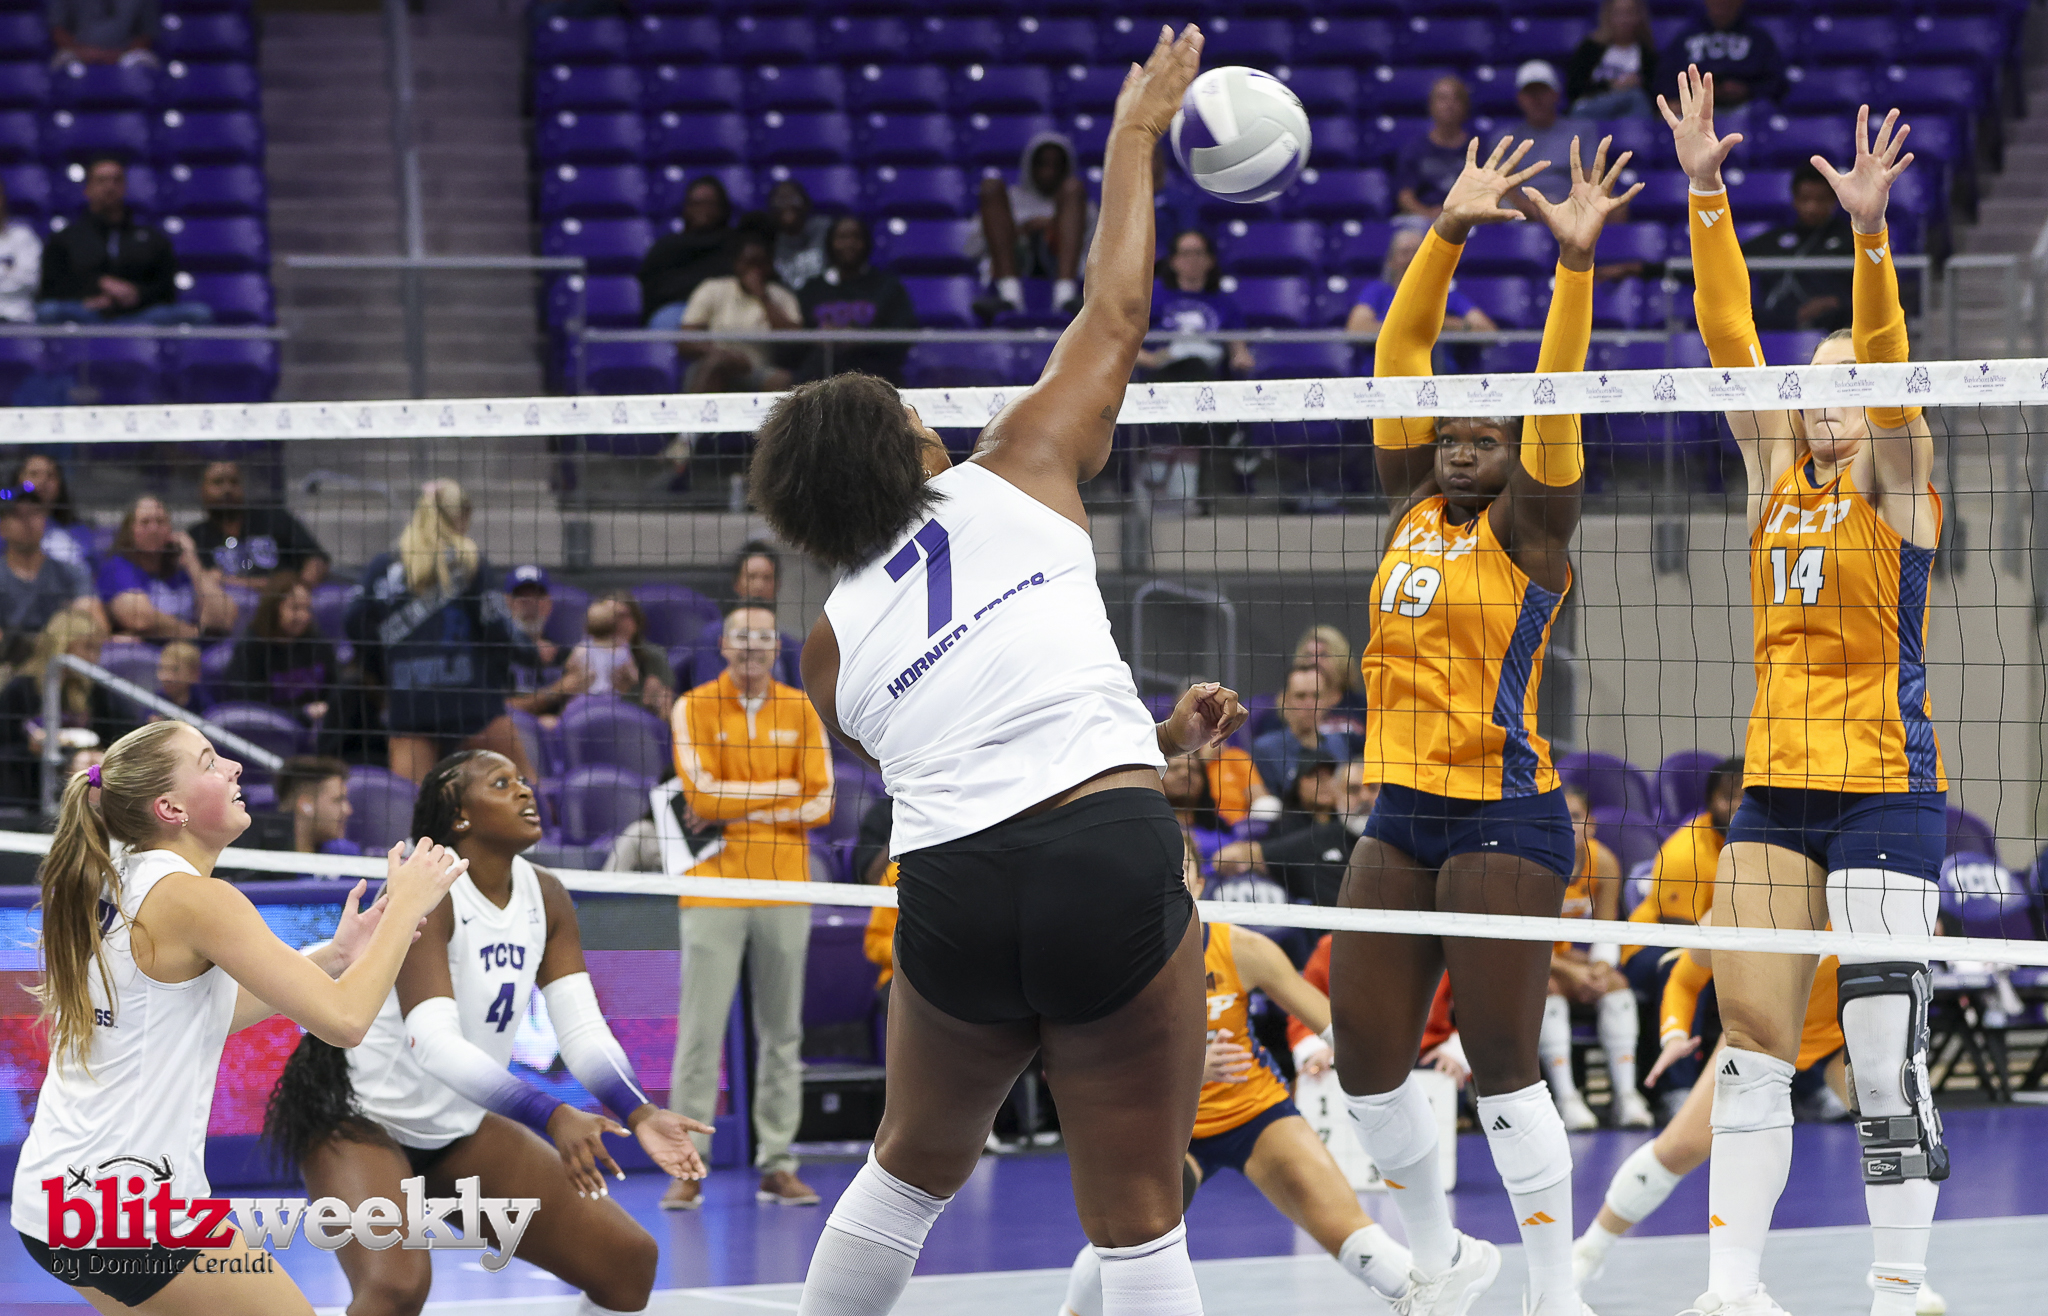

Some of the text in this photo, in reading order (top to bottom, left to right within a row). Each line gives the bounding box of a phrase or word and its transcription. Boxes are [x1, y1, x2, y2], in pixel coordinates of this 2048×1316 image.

[1684, 32, 1751, 63] TCU
[883, 517, 953, 639] 7
[1379, 560, 1442, 618] 19
[1769, 545, 1826, 605] 14
[1946, 862, 2012, 905] TCU
[479, 942, 526, 973] TCU
[485, 982, 515, 1033] 4
